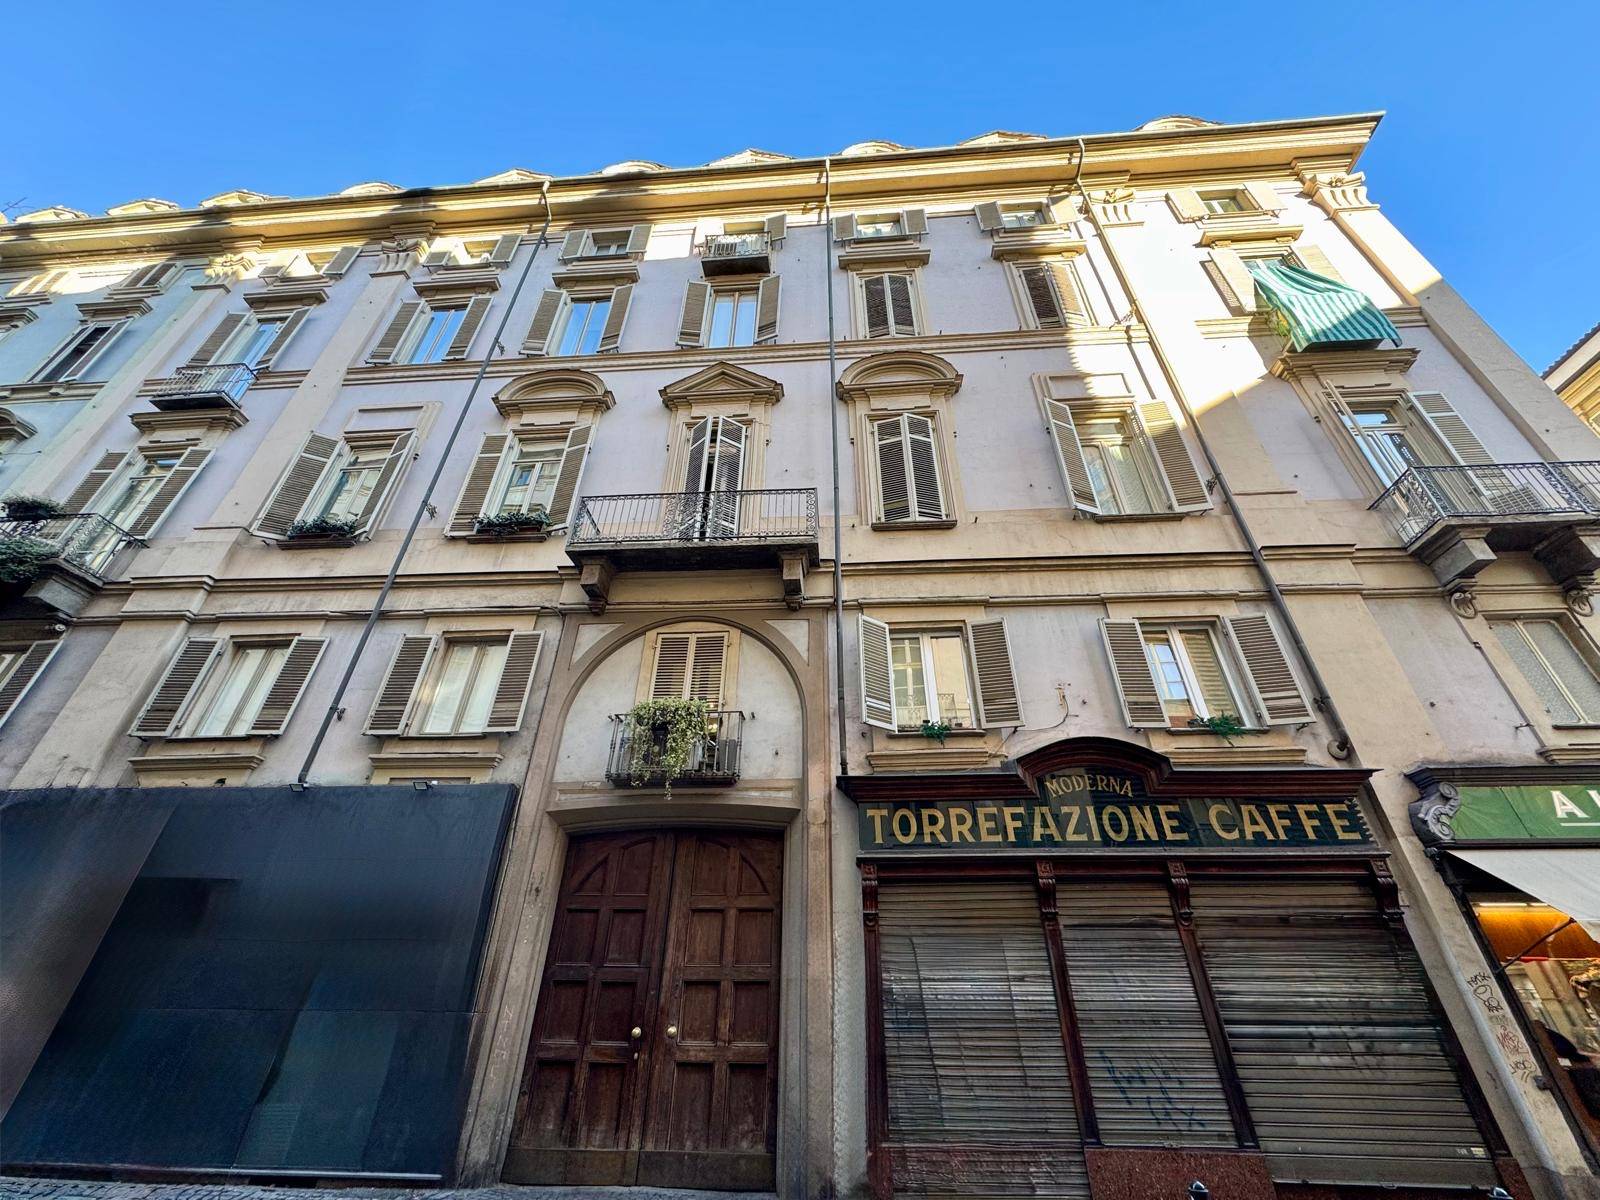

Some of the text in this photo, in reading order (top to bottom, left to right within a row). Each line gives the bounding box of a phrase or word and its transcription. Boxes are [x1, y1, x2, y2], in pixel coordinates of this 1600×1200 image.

[1044, 774, 1133, 798] MODERNA
[866, 803, 1362, 844] TORREFAZIONE CAFFE
